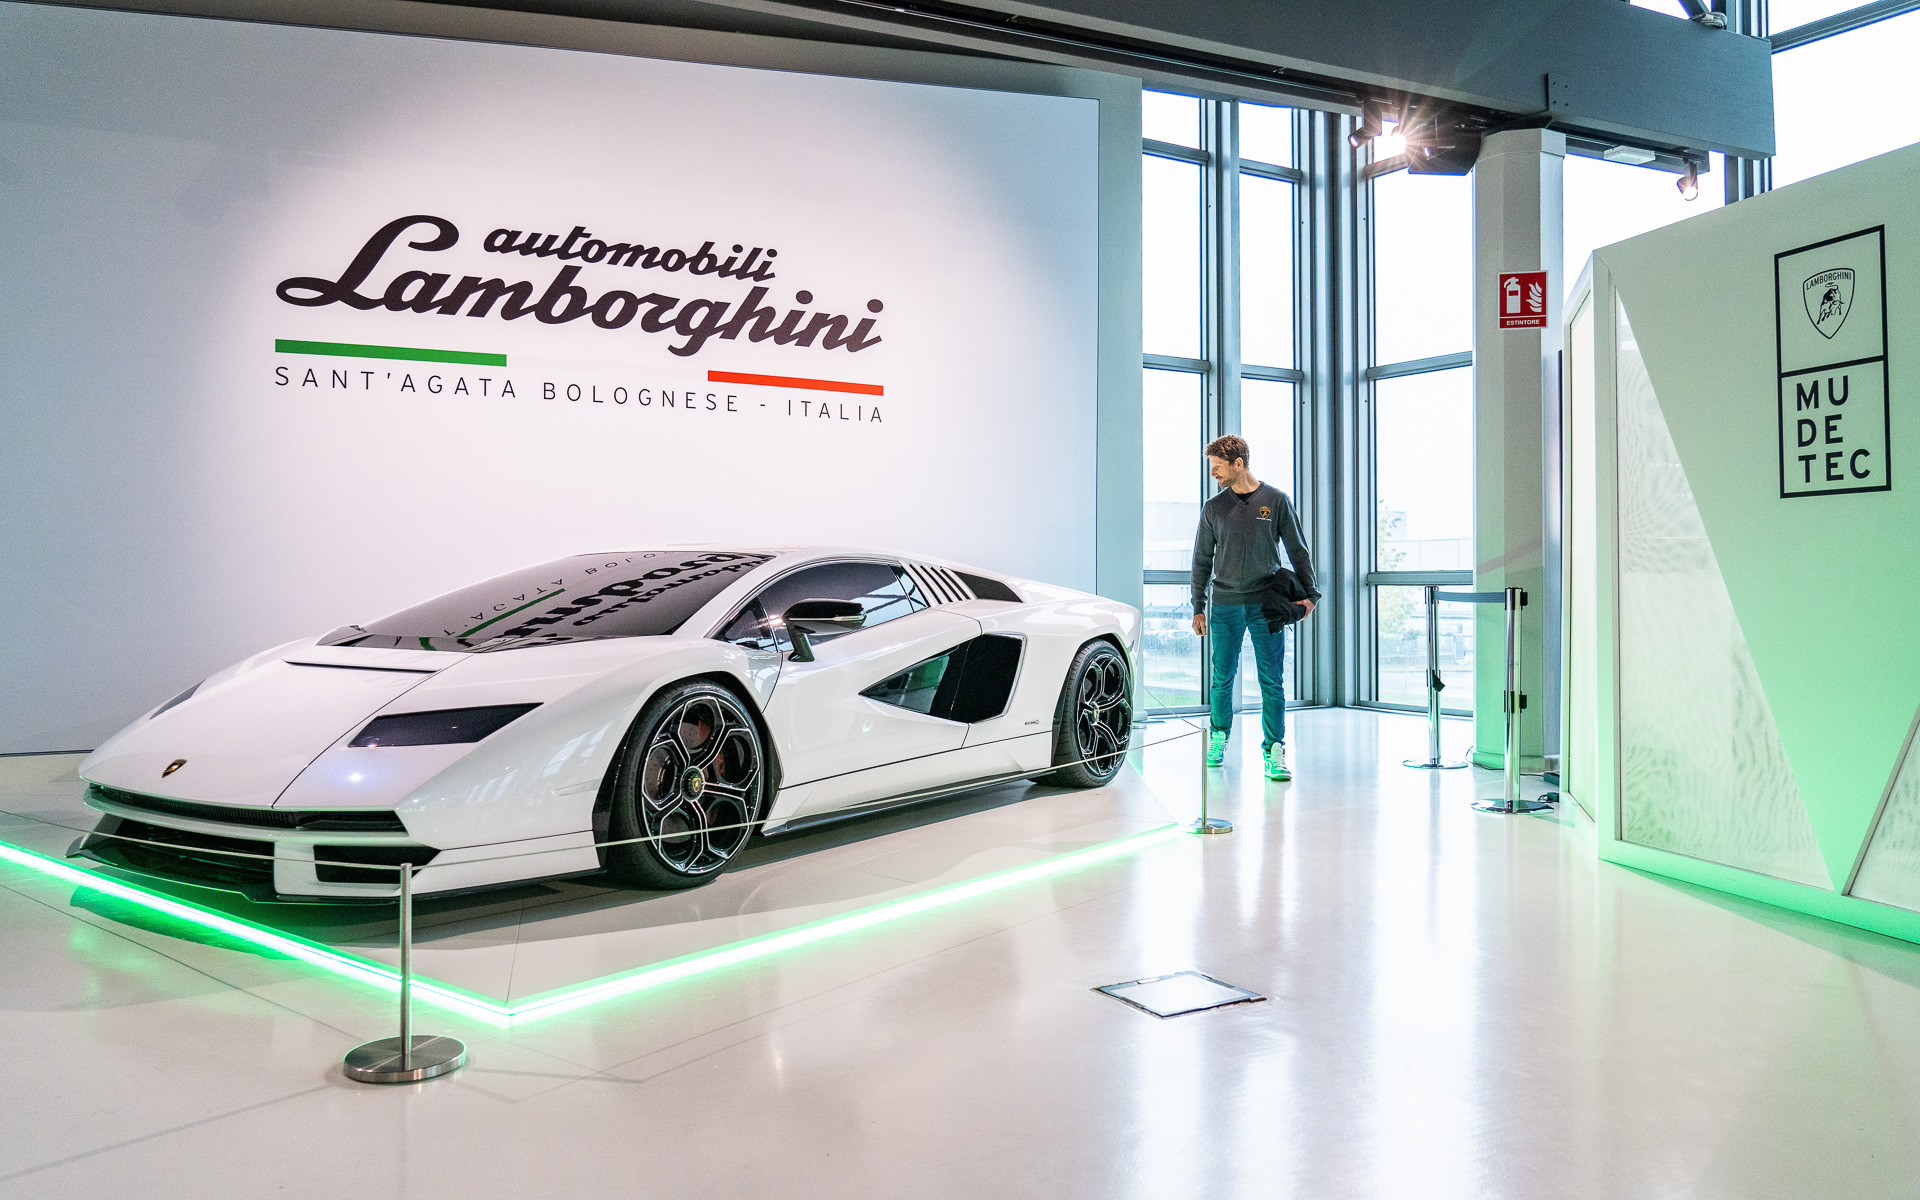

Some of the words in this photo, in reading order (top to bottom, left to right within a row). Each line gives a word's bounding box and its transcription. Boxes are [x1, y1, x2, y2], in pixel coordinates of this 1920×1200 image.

[483, 225, 778, 283] automobili
[275, 214, 884, 357] Lamborghini
[1805, 271, 1852, 291] LAMBORGHINI
[274, 366, 517, 399] SANT'AGATA
[542, 382, 739, 413] BOLOGNESE
[787, 399, 883, 424] ITALIA
[1796, 374, 1849, 412] MU
[1797, 413, 1844, 448] DE
[1797, 448, 1871, 484] TEC
